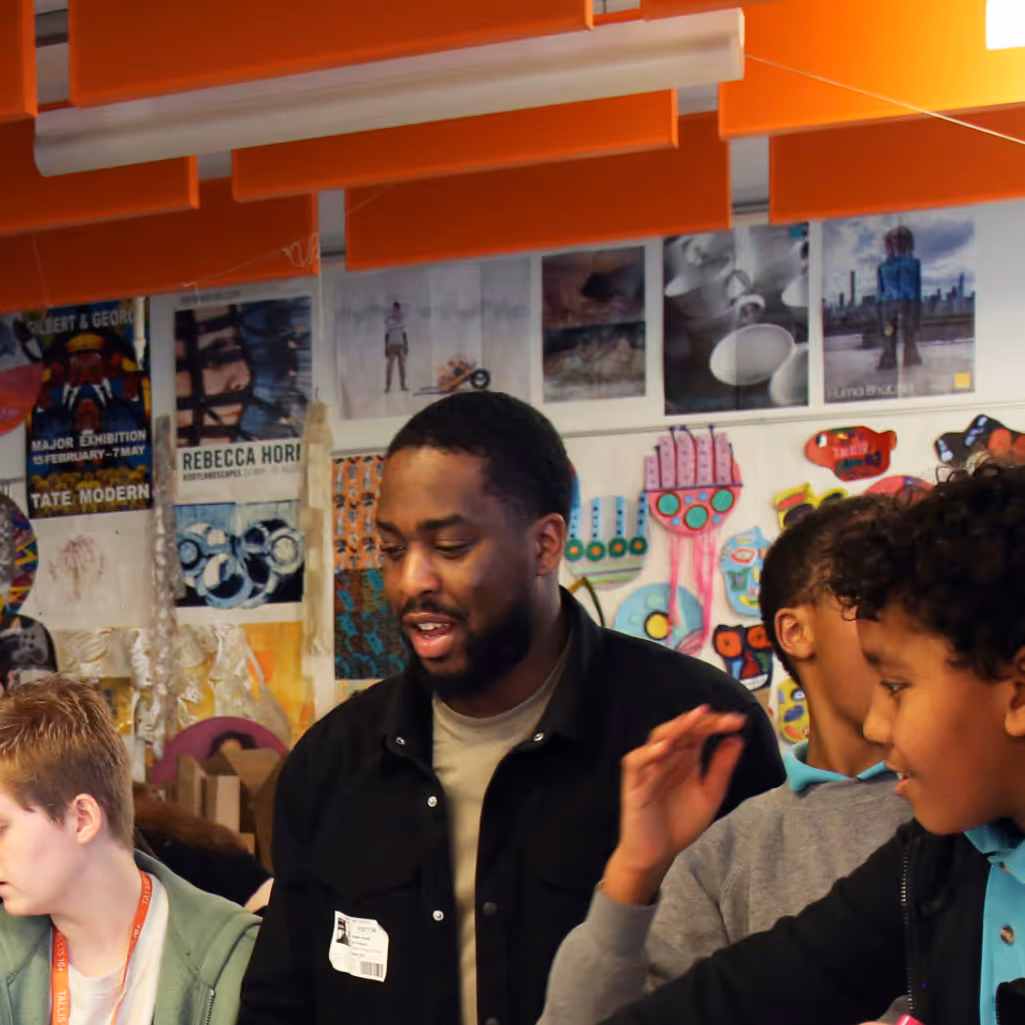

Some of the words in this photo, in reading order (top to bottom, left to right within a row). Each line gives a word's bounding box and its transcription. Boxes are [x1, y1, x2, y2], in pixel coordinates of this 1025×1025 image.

[80, 313, 88, 329] &
[31, 435, 74, 452] MAJOR
[79, 430, 146, 448] EXHIBITION
[32, 455, 44, 465] 15
[44, 449, 105, 464] FEBRUARY
[113, 448, 120, 457] 7
[120, 445, 145, 456] MAY
[183, 447, 256, 471] REBECCA
[30, 490, 72, 509] TATE
[79, 484, 150, 505] MODERN
[57, 931, 65, 957] ALLIS
[57, 990, 67, 1023] TALLIS
